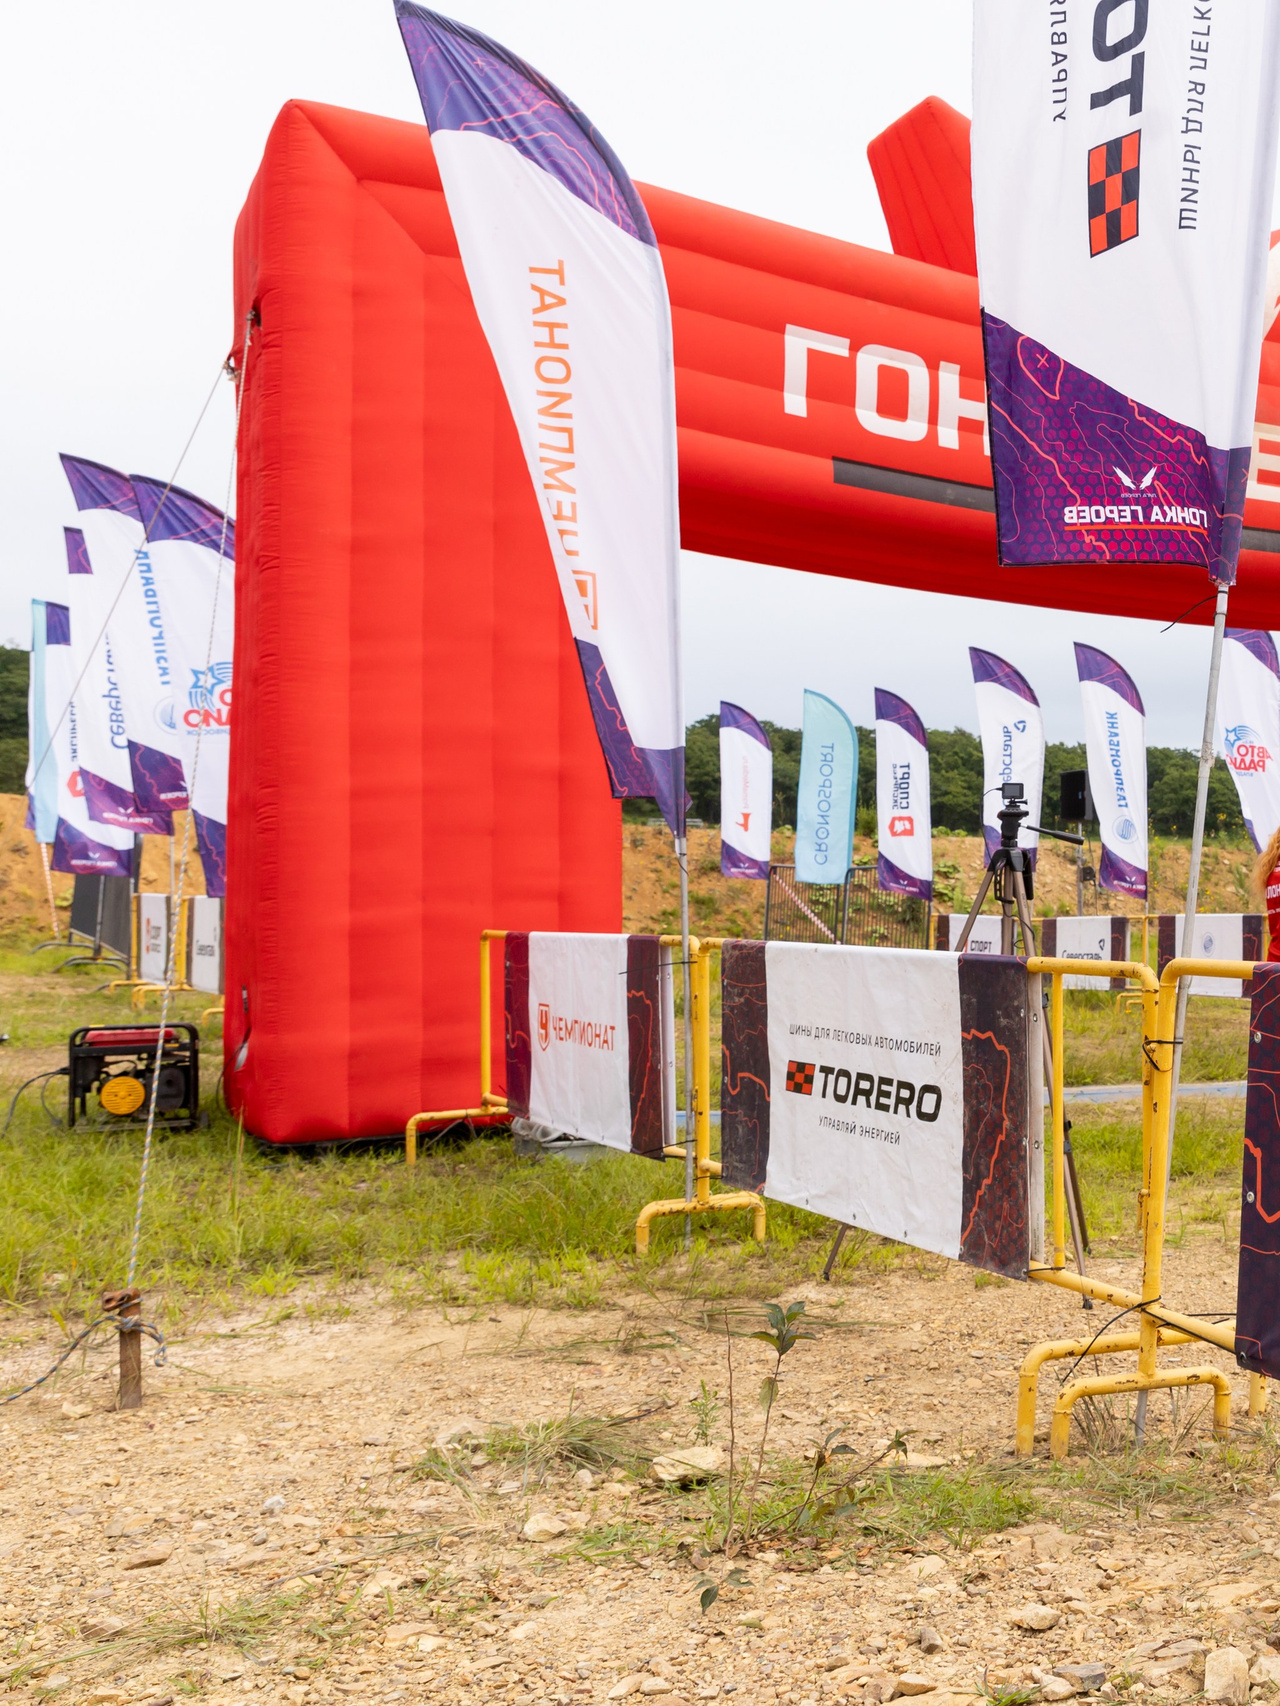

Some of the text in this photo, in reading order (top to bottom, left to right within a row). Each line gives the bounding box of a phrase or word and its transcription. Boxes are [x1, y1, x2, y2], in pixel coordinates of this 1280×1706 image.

[783, 323, 991, 457] ГОН
[970, 940, 992, 953] СПОРТ
[552, 1015, 616, 1051] ЧЕМПИОНАТ
[789, 1023, 942, 1057] ШИНЫ ДЛЯ ЛЕГКОВЫХ АВТОМОБИЛЕЙ
[819, 1065, 943, 1123] TORERO
[819, 1115, 901, 1146] УПРАВЛЯЙ ЭНЕРГИЕЙ
